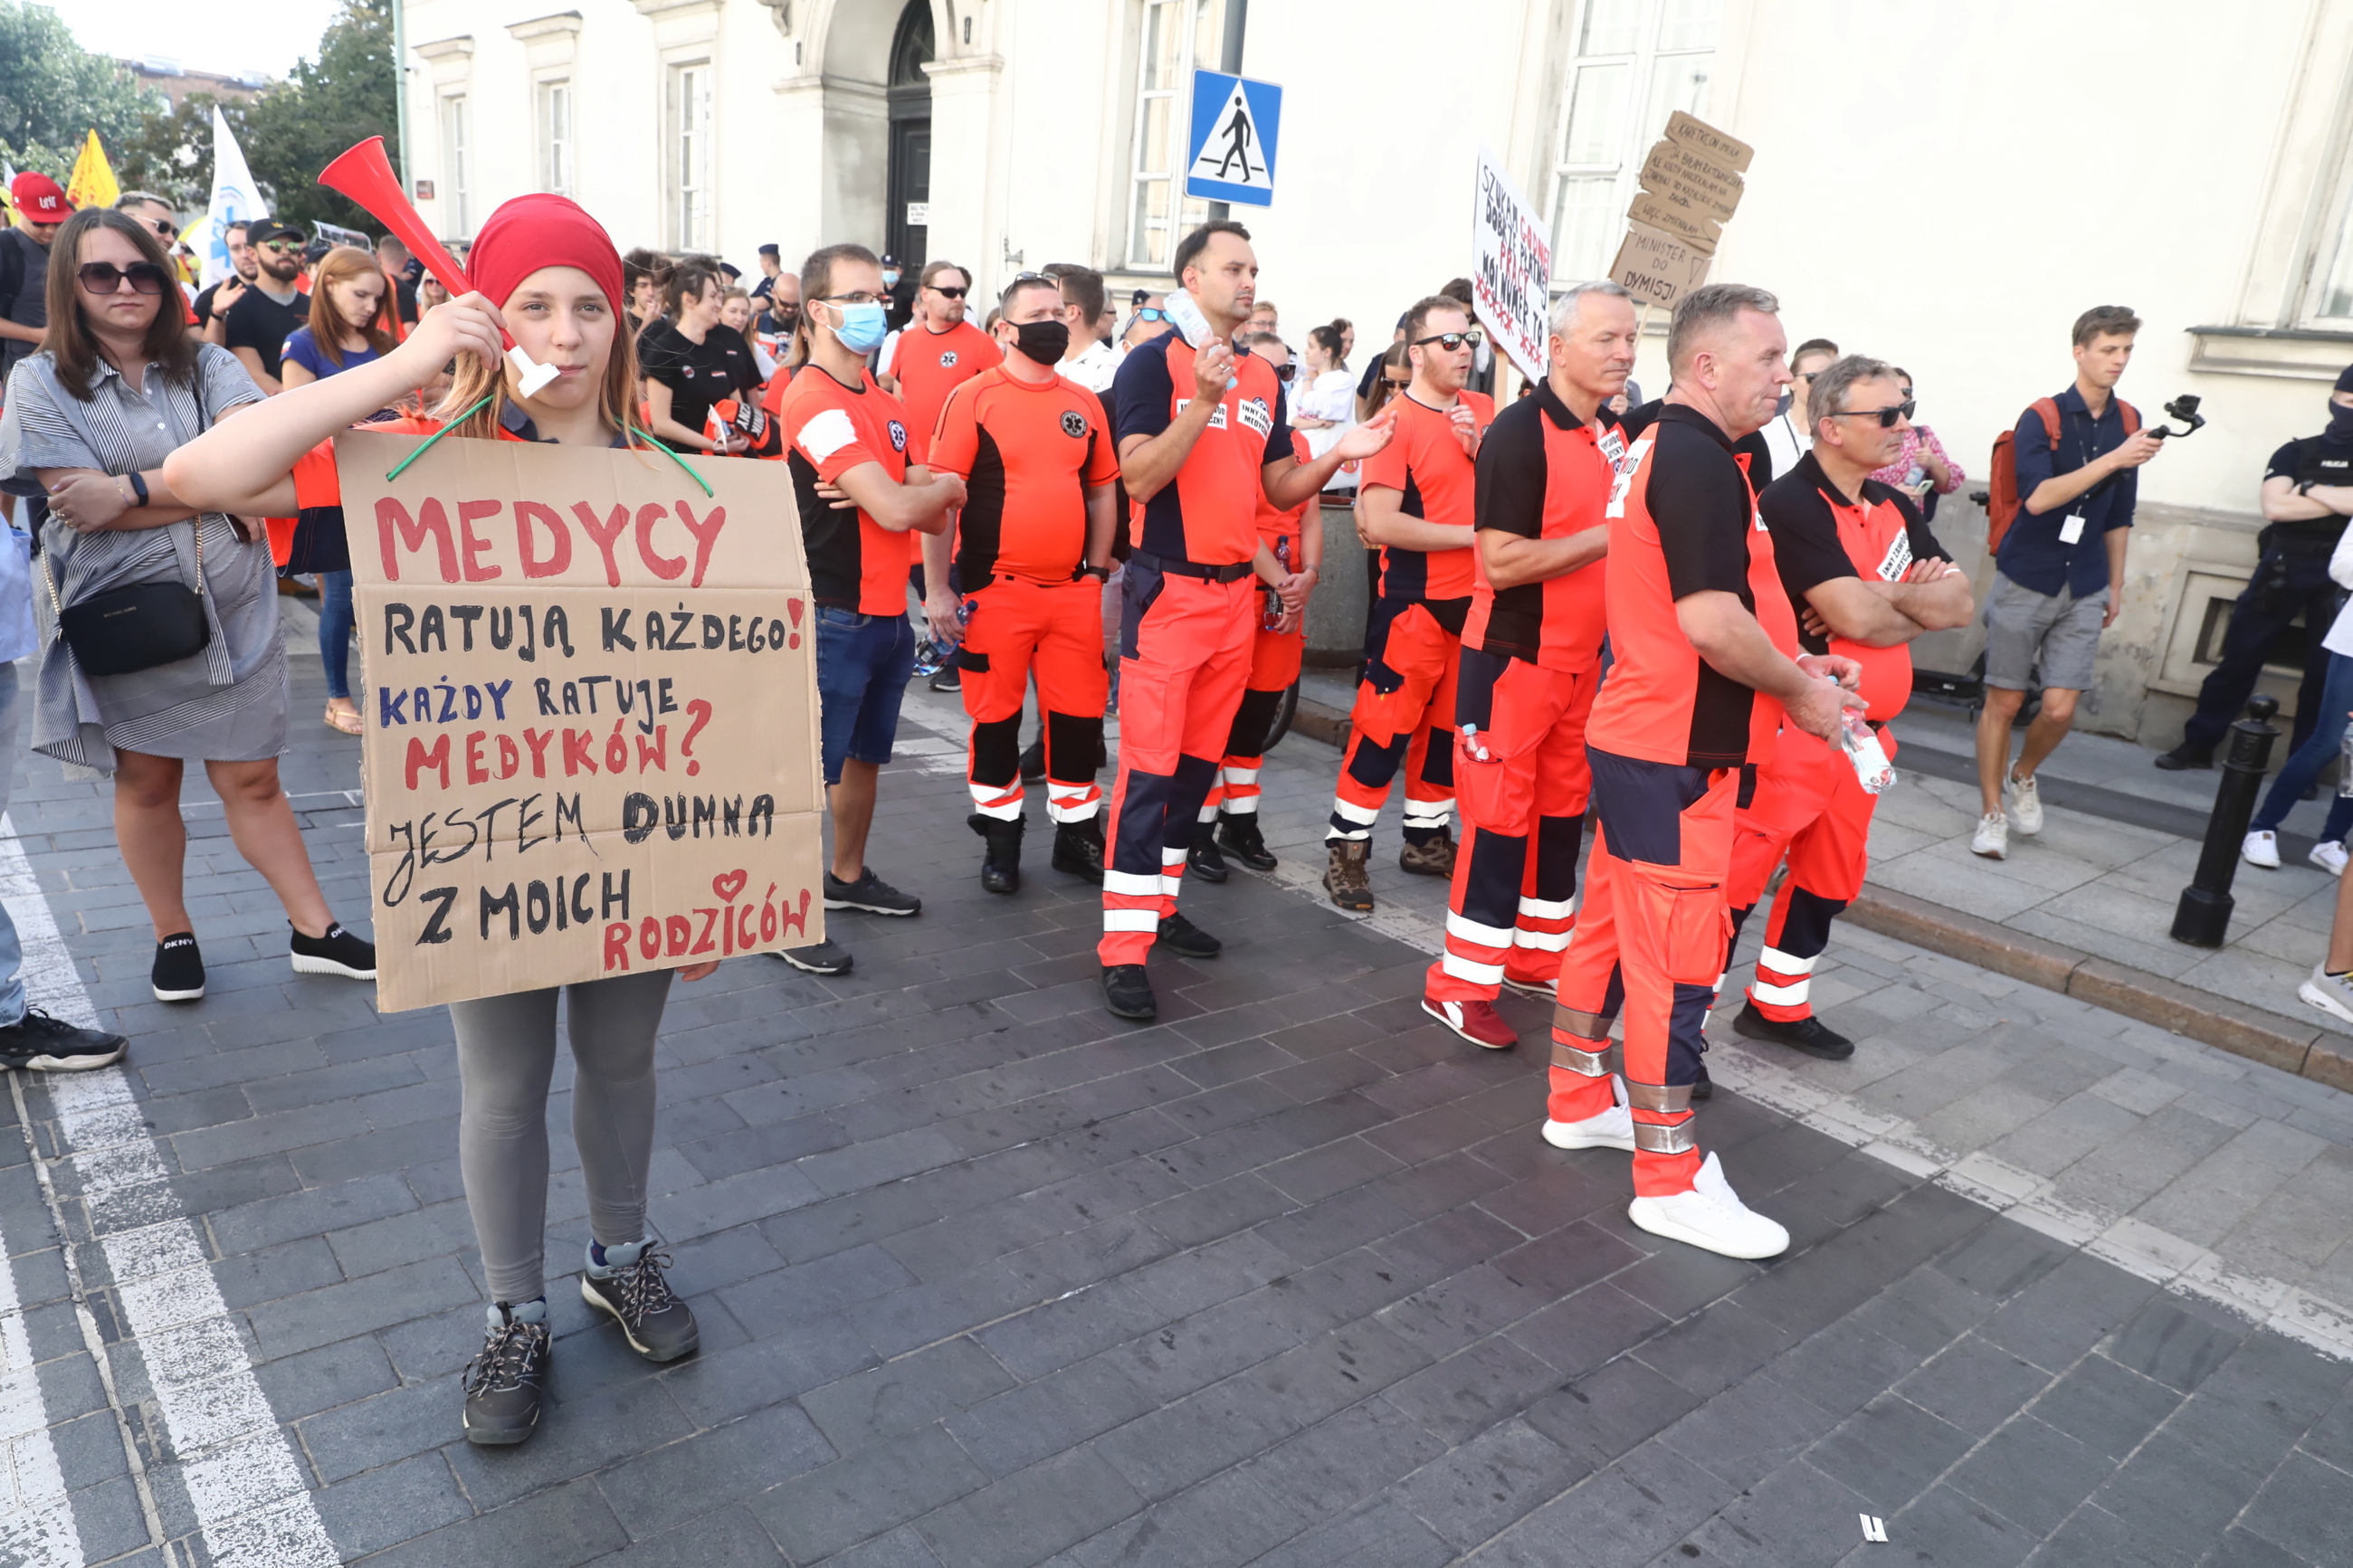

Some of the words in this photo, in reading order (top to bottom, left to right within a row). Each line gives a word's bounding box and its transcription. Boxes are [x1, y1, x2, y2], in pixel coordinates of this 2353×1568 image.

[1481, 164, 1519, 234] SZUKAM
[1486, 195, 1517, 256] DOBRZE
[1500, 240, 1529, 300] PRACY
[1635, 234, 1687, 263] MINISTER
[1653, 257, 1669, 271] DO
[1500, 271, 1529, 335] NUMER
[1533, 309, 1543, 347] TO
[1624, 271, 1677, 301] DYMISJI
[1242, 404, 1259, 417] INNY
[375, 496, 727, 588] MEDYCY
[1881, 556, 1896, 576] INNY
[384, 602, 576, 662] RATUJĄ
[379, 675, 514, 728] KAŻDY
[534, 675, 680, 735] RATUJE
[405, 698, 713, 791] MEDYKÓW?
[383, 792, 604, 908] JESTEM
[623, 791, 775, 845] DUMNA
[414, 887, 459, 947] Z
[480, 868, 631, 941] MOICH
[602, 881, 813, 972] RODZICÓW
[164, 938, 194, 950] DKNY
